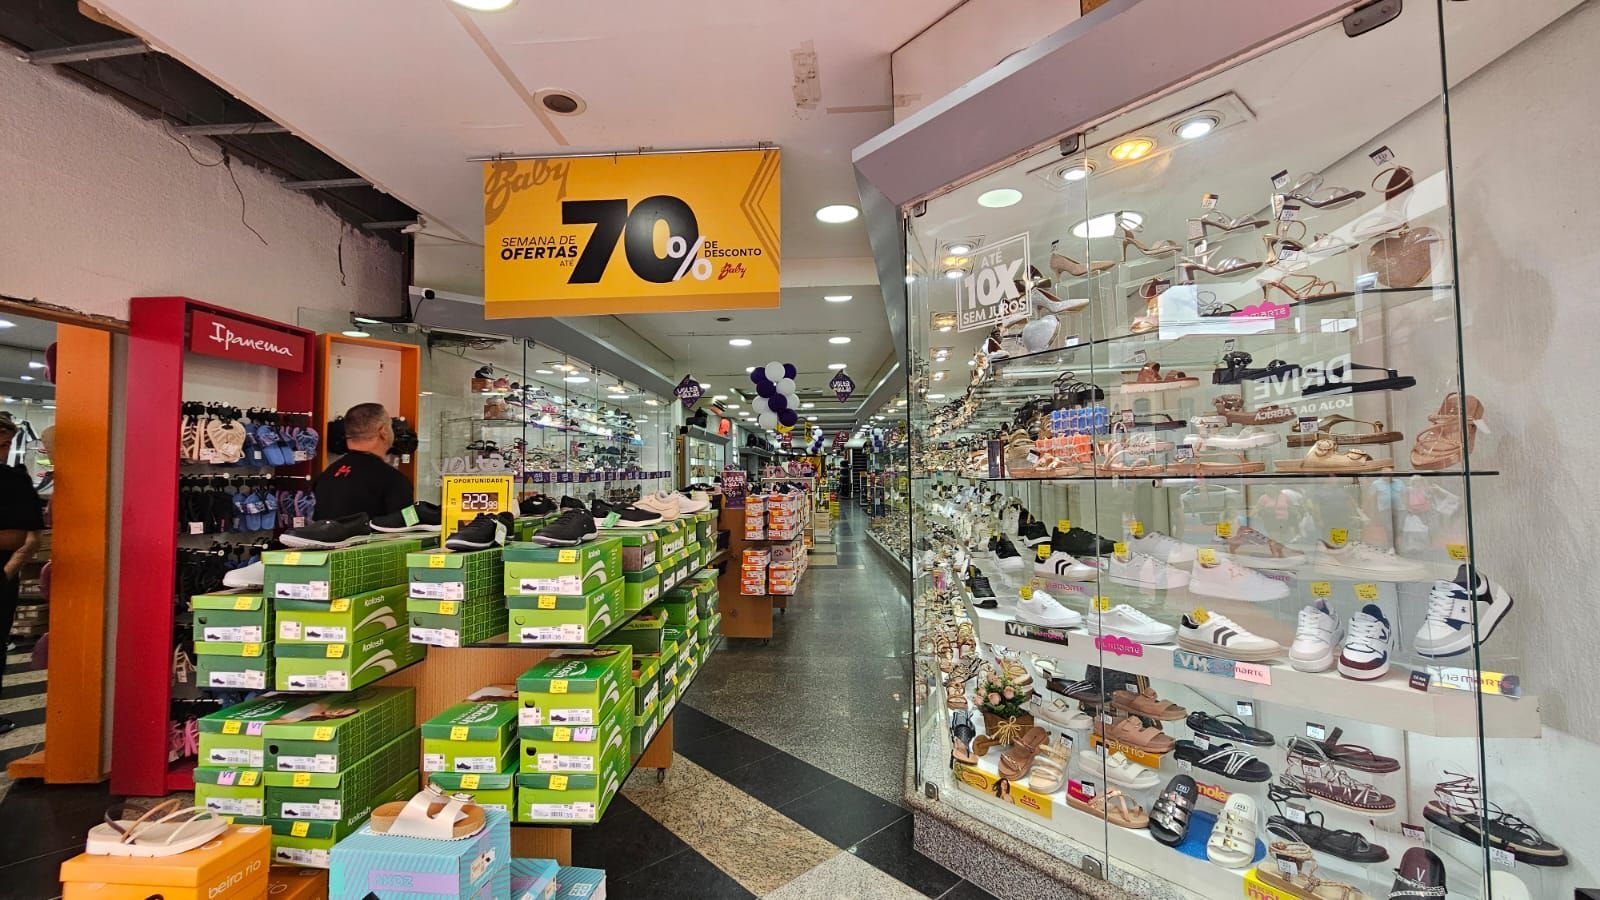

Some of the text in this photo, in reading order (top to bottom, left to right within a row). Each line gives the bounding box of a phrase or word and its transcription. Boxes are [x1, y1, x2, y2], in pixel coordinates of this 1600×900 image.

[484, 158, 570, 225] Baby
[501, 235, 577, 248] SEMANA DE
[561, 194, 713, 285] 70%
[704, 240, 718, 250] DE
[500, 245, 578, 261] OFERTAS
[704, 248, 762, 258] DESCONTO
[559, 258, 575, 268] ATÉ
[717, 262, 747, 281] Baby
[964, 258, 1024, 309] 10X
[963, 299, 1026, 326] SEM JUROS
[208, 320, 294, 357] Ipanema
[462, 492, 498, 511] 229,99
[1008, 622, 1028, 636] VM
[1179, 652, 1210, 673] VM
[252, 722, 262, 730] VT
[578, 727, 590, 735] VT
[1110, 741, 1146, 758] eira rio
[208, 871, 243, 899] beira
[245, 860, 262, 877] rio
